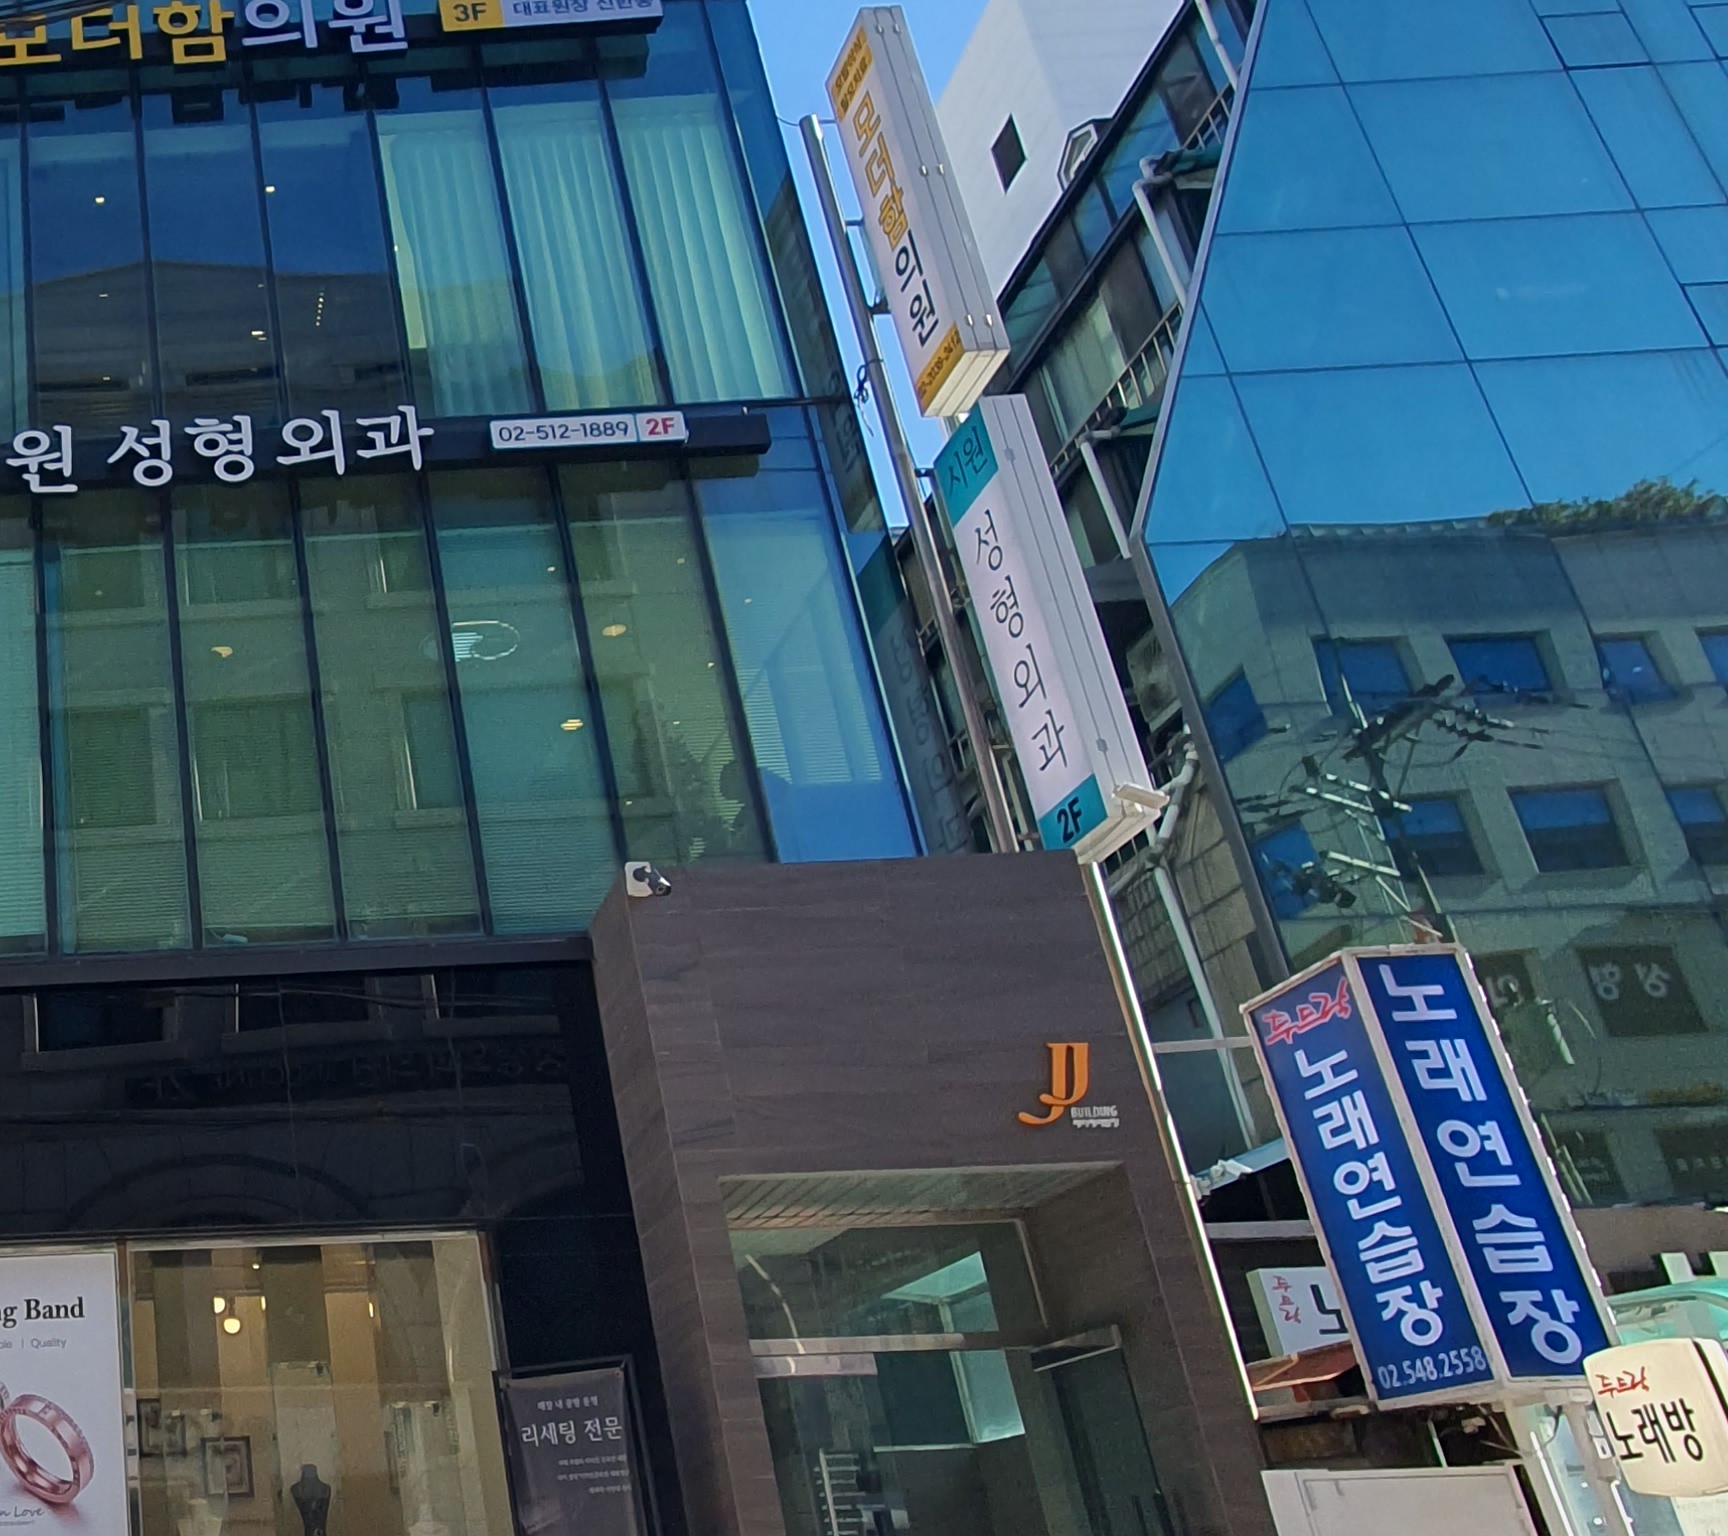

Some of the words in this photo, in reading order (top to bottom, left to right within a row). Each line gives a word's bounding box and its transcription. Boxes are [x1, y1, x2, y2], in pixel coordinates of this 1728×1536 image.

[453, 2, 487, 23] 3F
[853, 90, 939, 348] 모더함의원
[497, 416, 630, 445] 02-512-1889
[644, 415, 675, 440] 2F
[947, 425, 989, 496] 시원
[974, 509, 1068, 773] 성형외과
[1056, 795, 1086, 844] 2F
[1070, 1105, 1118, 1118] BUILDING
[1378, 963, 1584, 1366] 노래연습장
[1294, 1048, 1444, 1348] 노래연습장
[24, 1296, 86, 1322] Band
[30, 1337, 68, 1350] Quality
[1377, 1345, 1488, 1390] 02.548.2558
[521, 1419, 577, 1447] 리세팅
[584, 1416, 623, 1442] 전문
[1606, 1397, 1704, 1464] 노래방
[14, 1507, 45, 1518] Love
